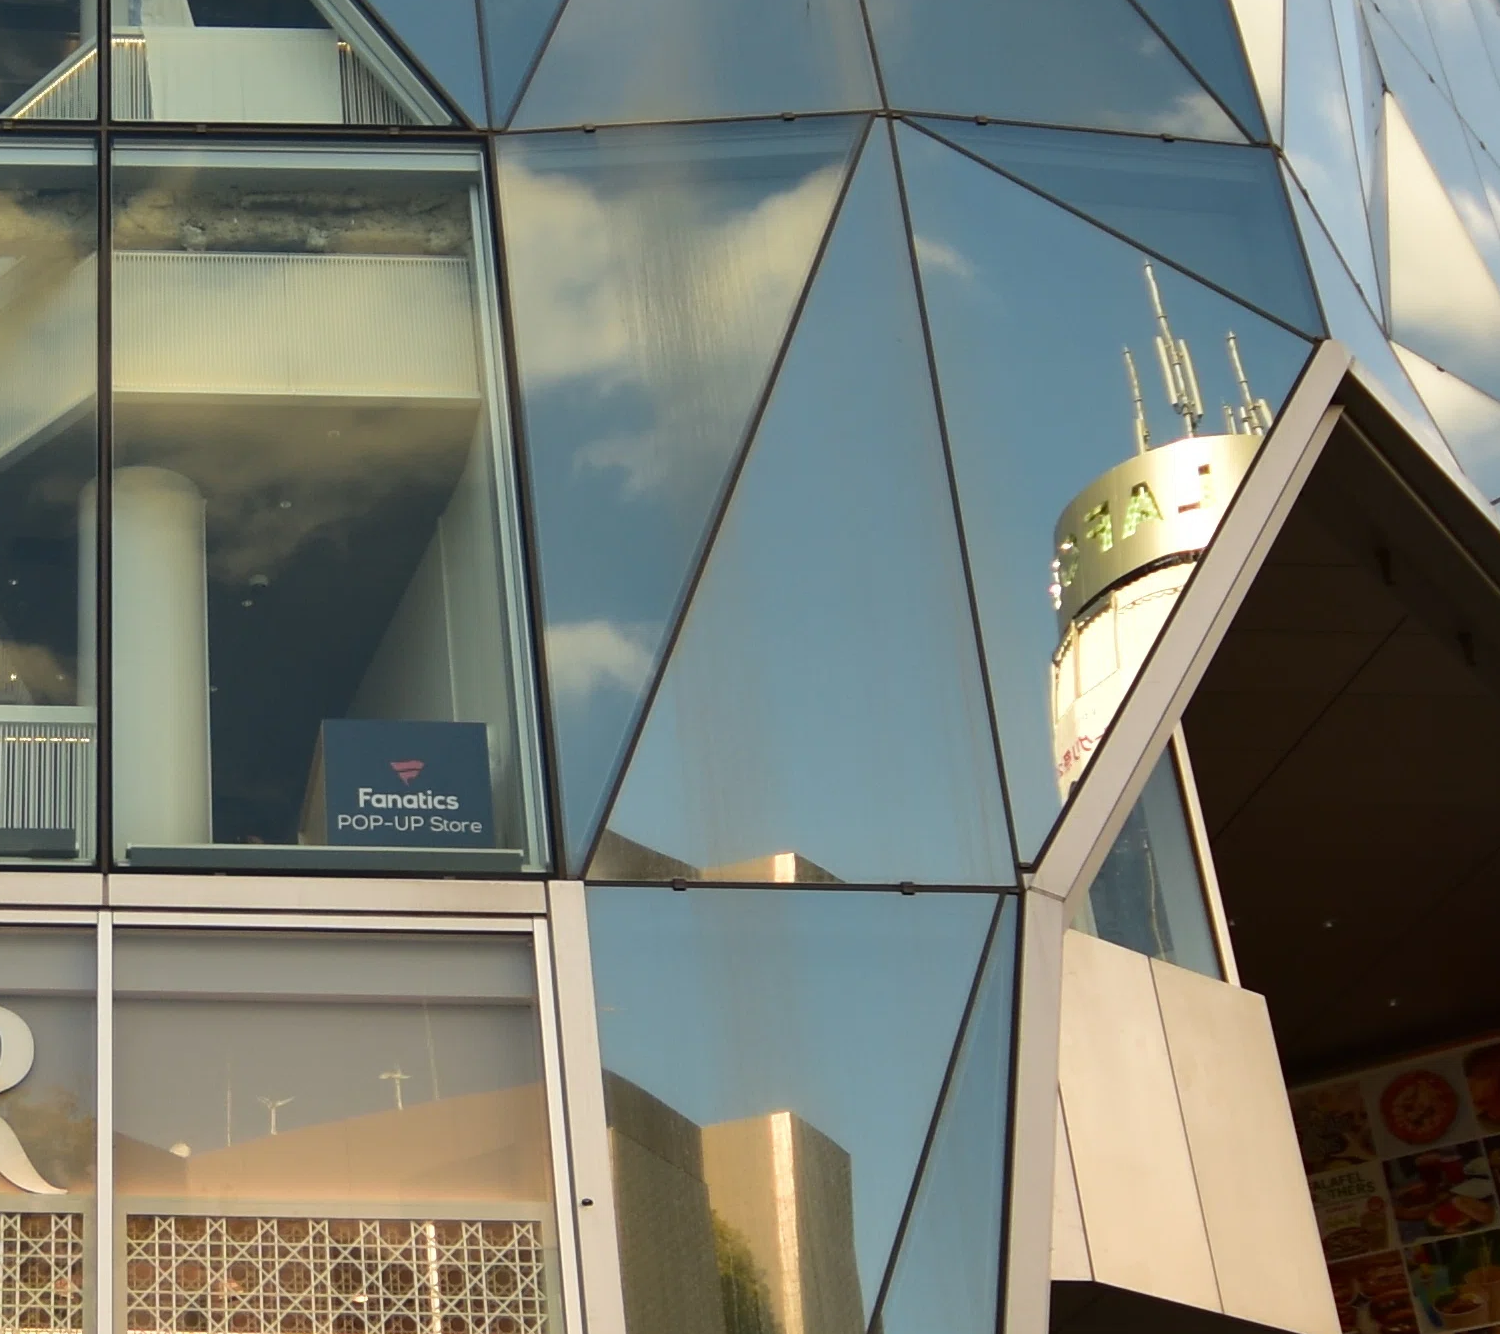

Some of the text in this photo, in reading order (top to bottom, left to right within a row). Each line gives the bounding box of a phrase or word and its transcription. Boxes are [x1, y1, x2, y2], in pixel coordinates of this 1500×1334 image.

[358, 787, 459, 810] Fanatics
[337, 814, 482, 833] POP-UP Store
